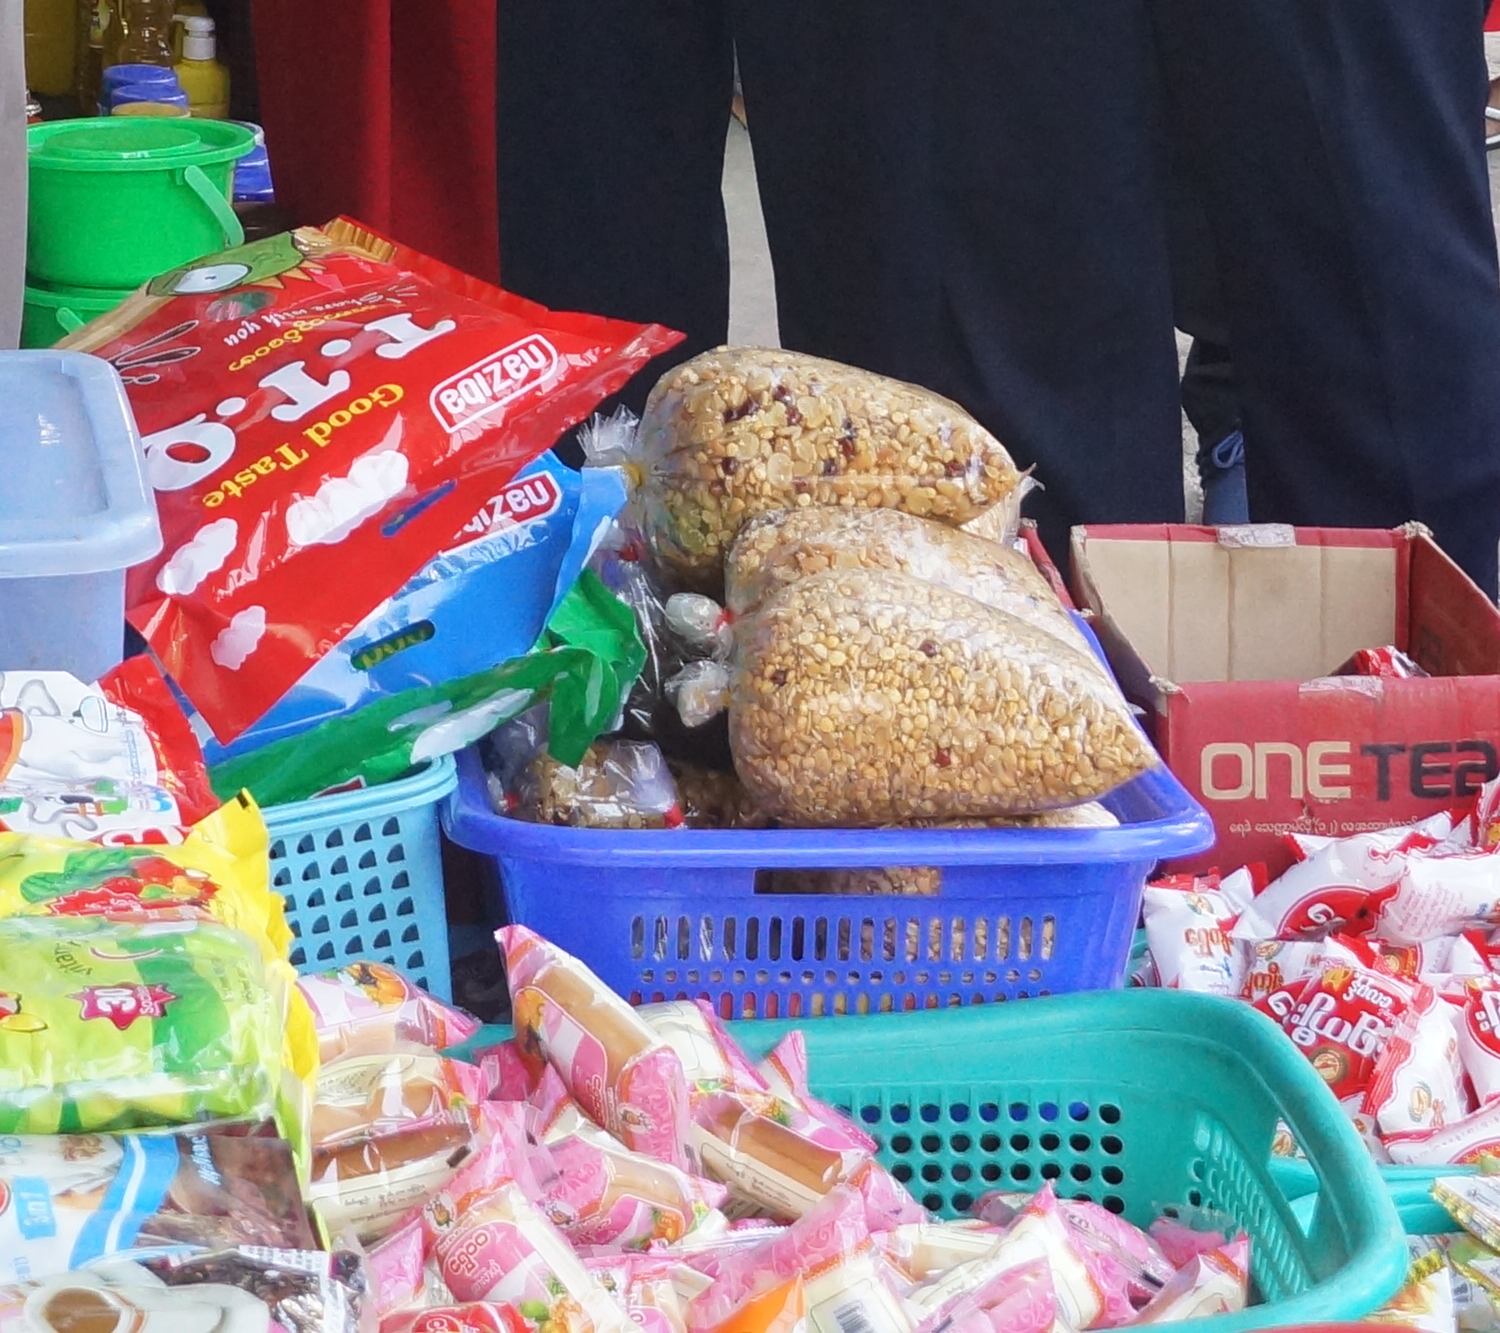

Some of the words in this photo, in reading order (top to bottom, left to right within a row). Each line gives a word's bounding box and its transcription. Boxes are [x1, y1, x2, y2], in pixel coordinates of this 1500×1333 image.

[222, 320, 261, 347] you
[304, 382, 404, 448] Good
[203, 440, 308, 510] Taste
[480, 479, 550, 533] nazi
